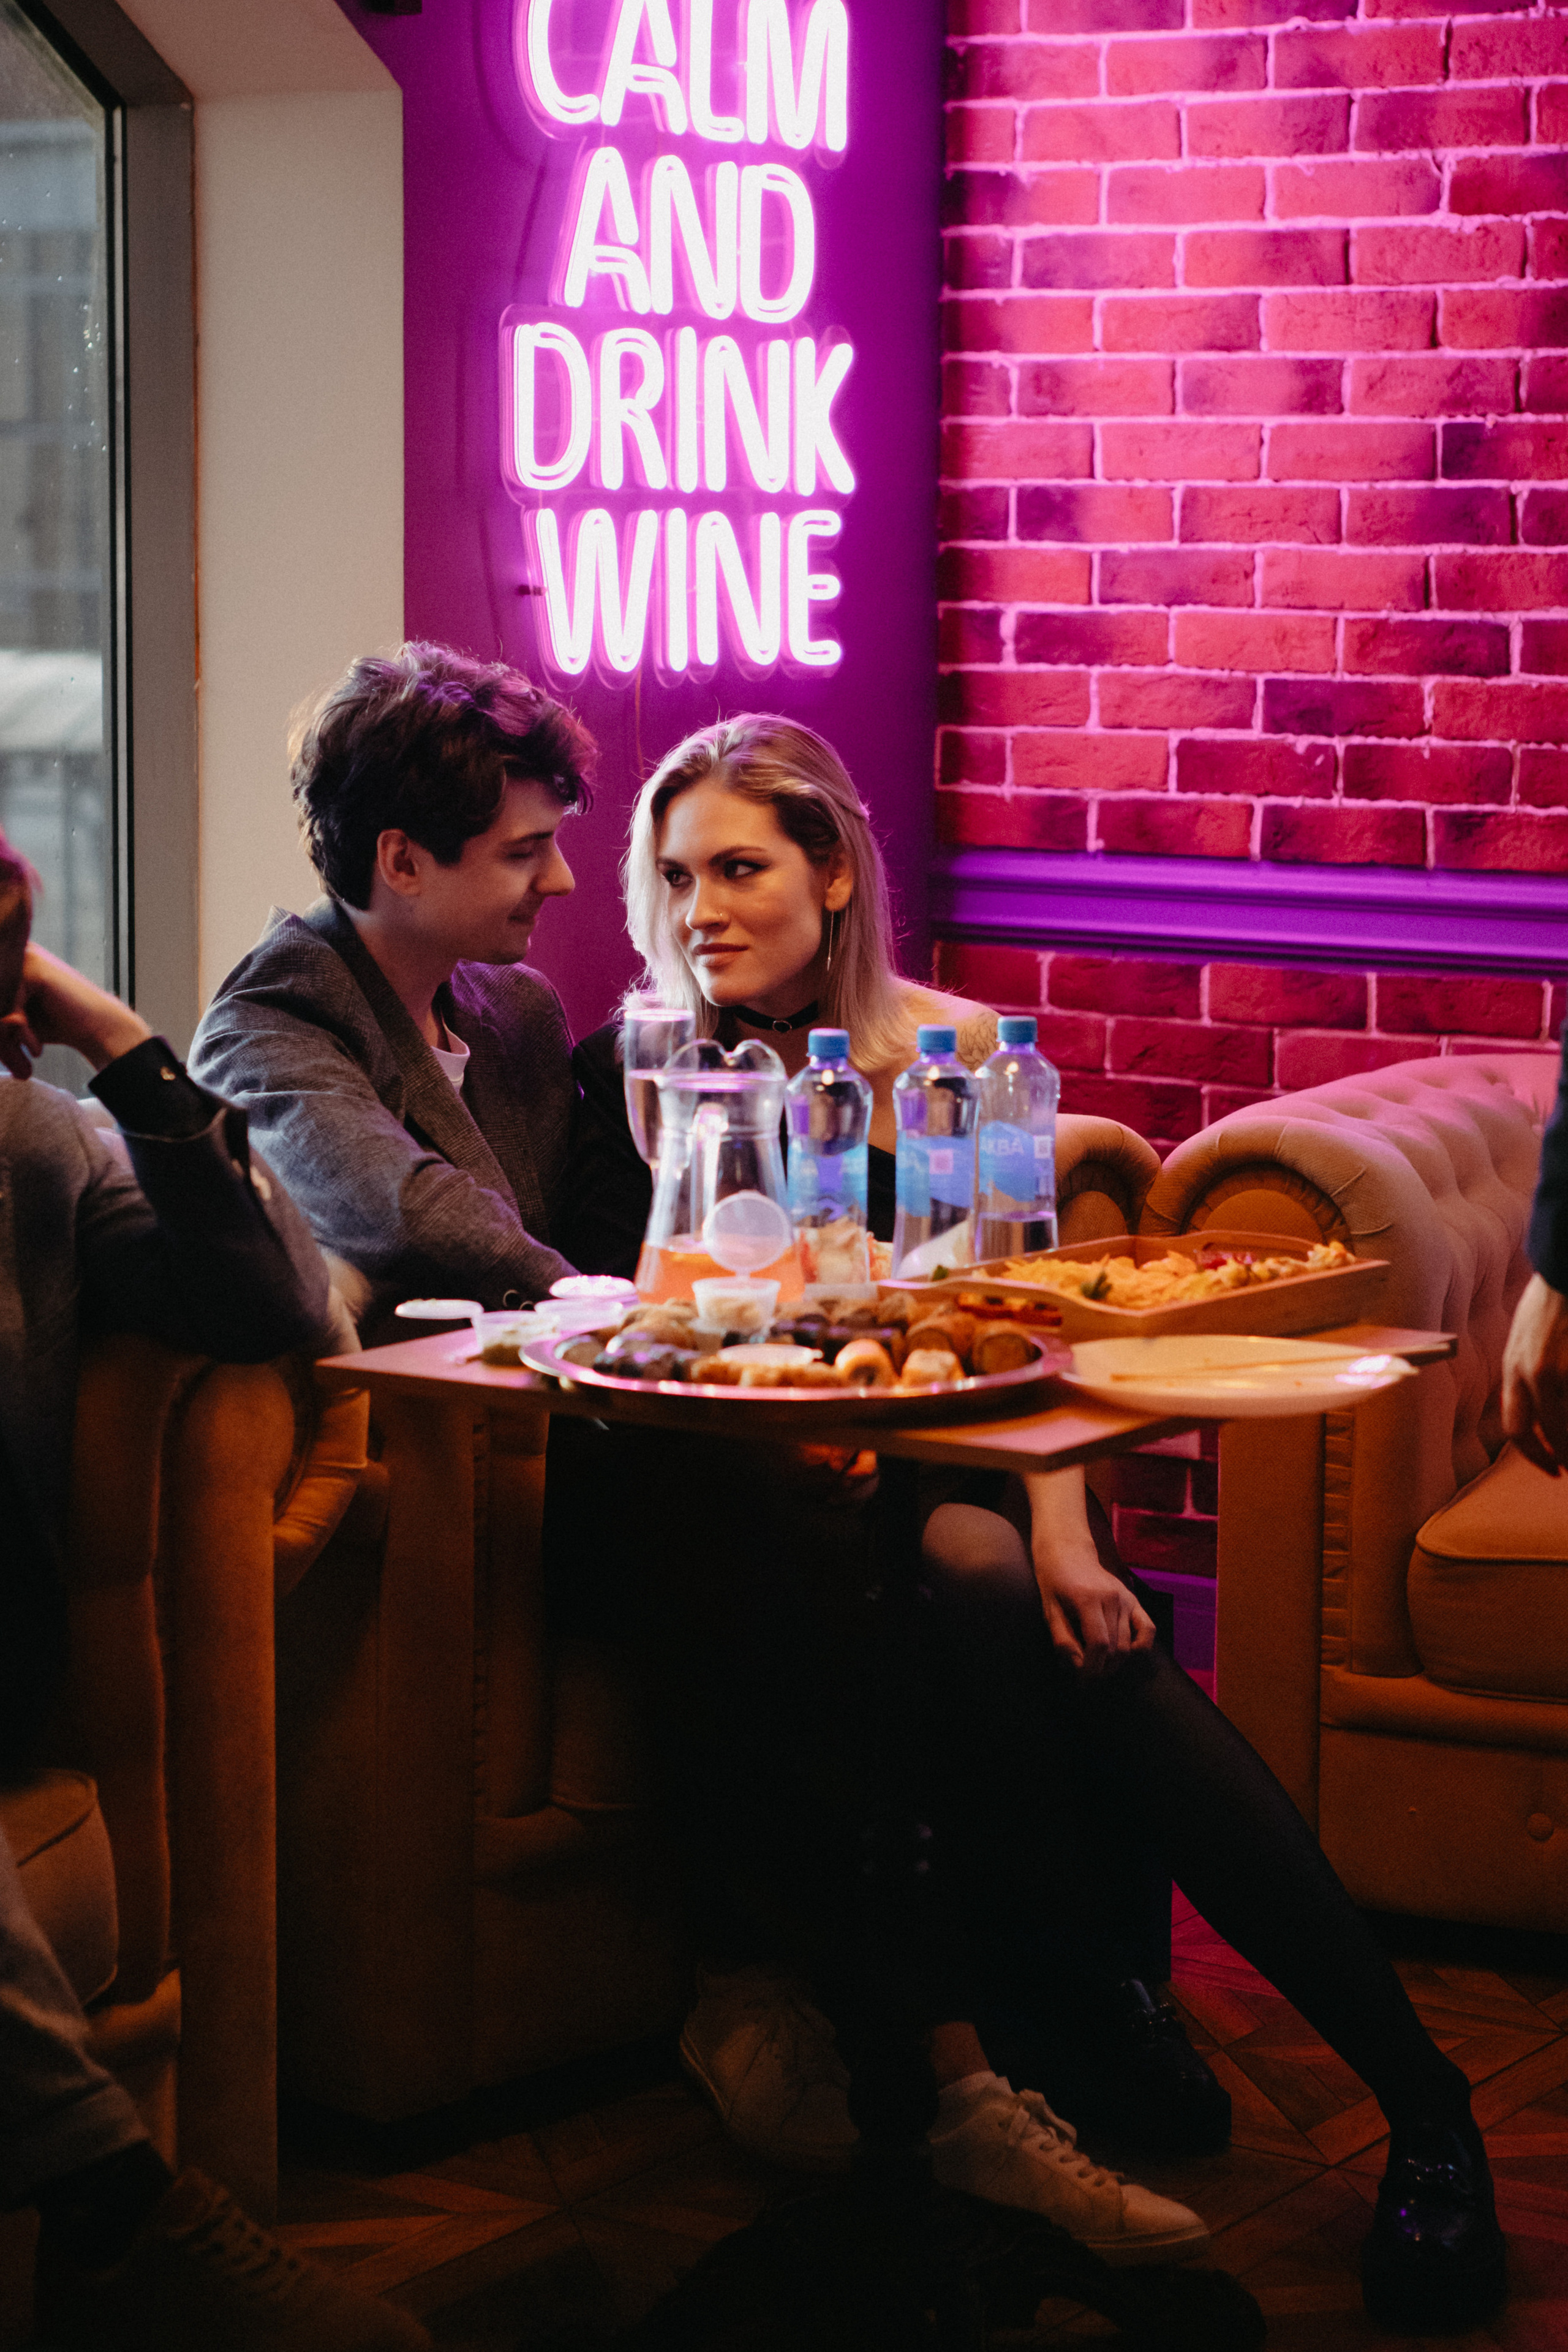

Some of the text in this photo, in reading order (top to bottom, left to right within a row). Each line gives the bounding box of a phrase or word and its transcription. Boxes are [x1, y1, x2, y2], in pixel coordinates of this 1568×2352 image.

[524, 0, 850, 152] CALM
[561, 146, 816, 324] AND
[511, 322, 856, 497] DRINK
[534, 507, 843, 676] WINE
